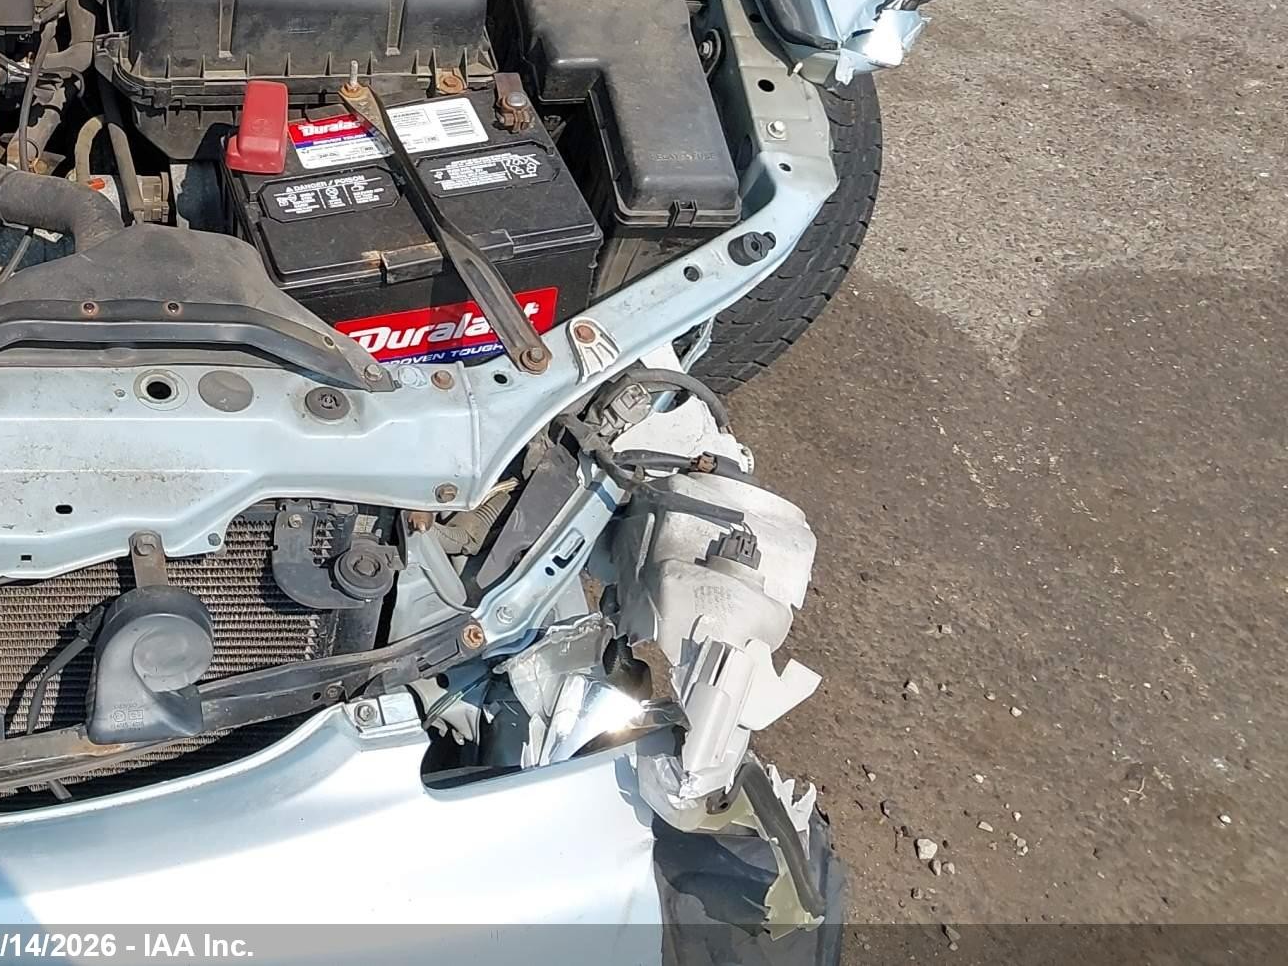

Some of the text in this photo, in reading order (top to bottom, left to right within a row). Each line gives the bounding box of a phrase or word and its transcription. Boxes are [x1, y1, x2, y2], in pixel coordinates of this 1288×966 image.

[294, 181, 328, 192] DANGER
[334, 175, 365, 185] POISON
[347, 302, 540, 354] Duralat
[450, 344, 504, 358] TOUGH
